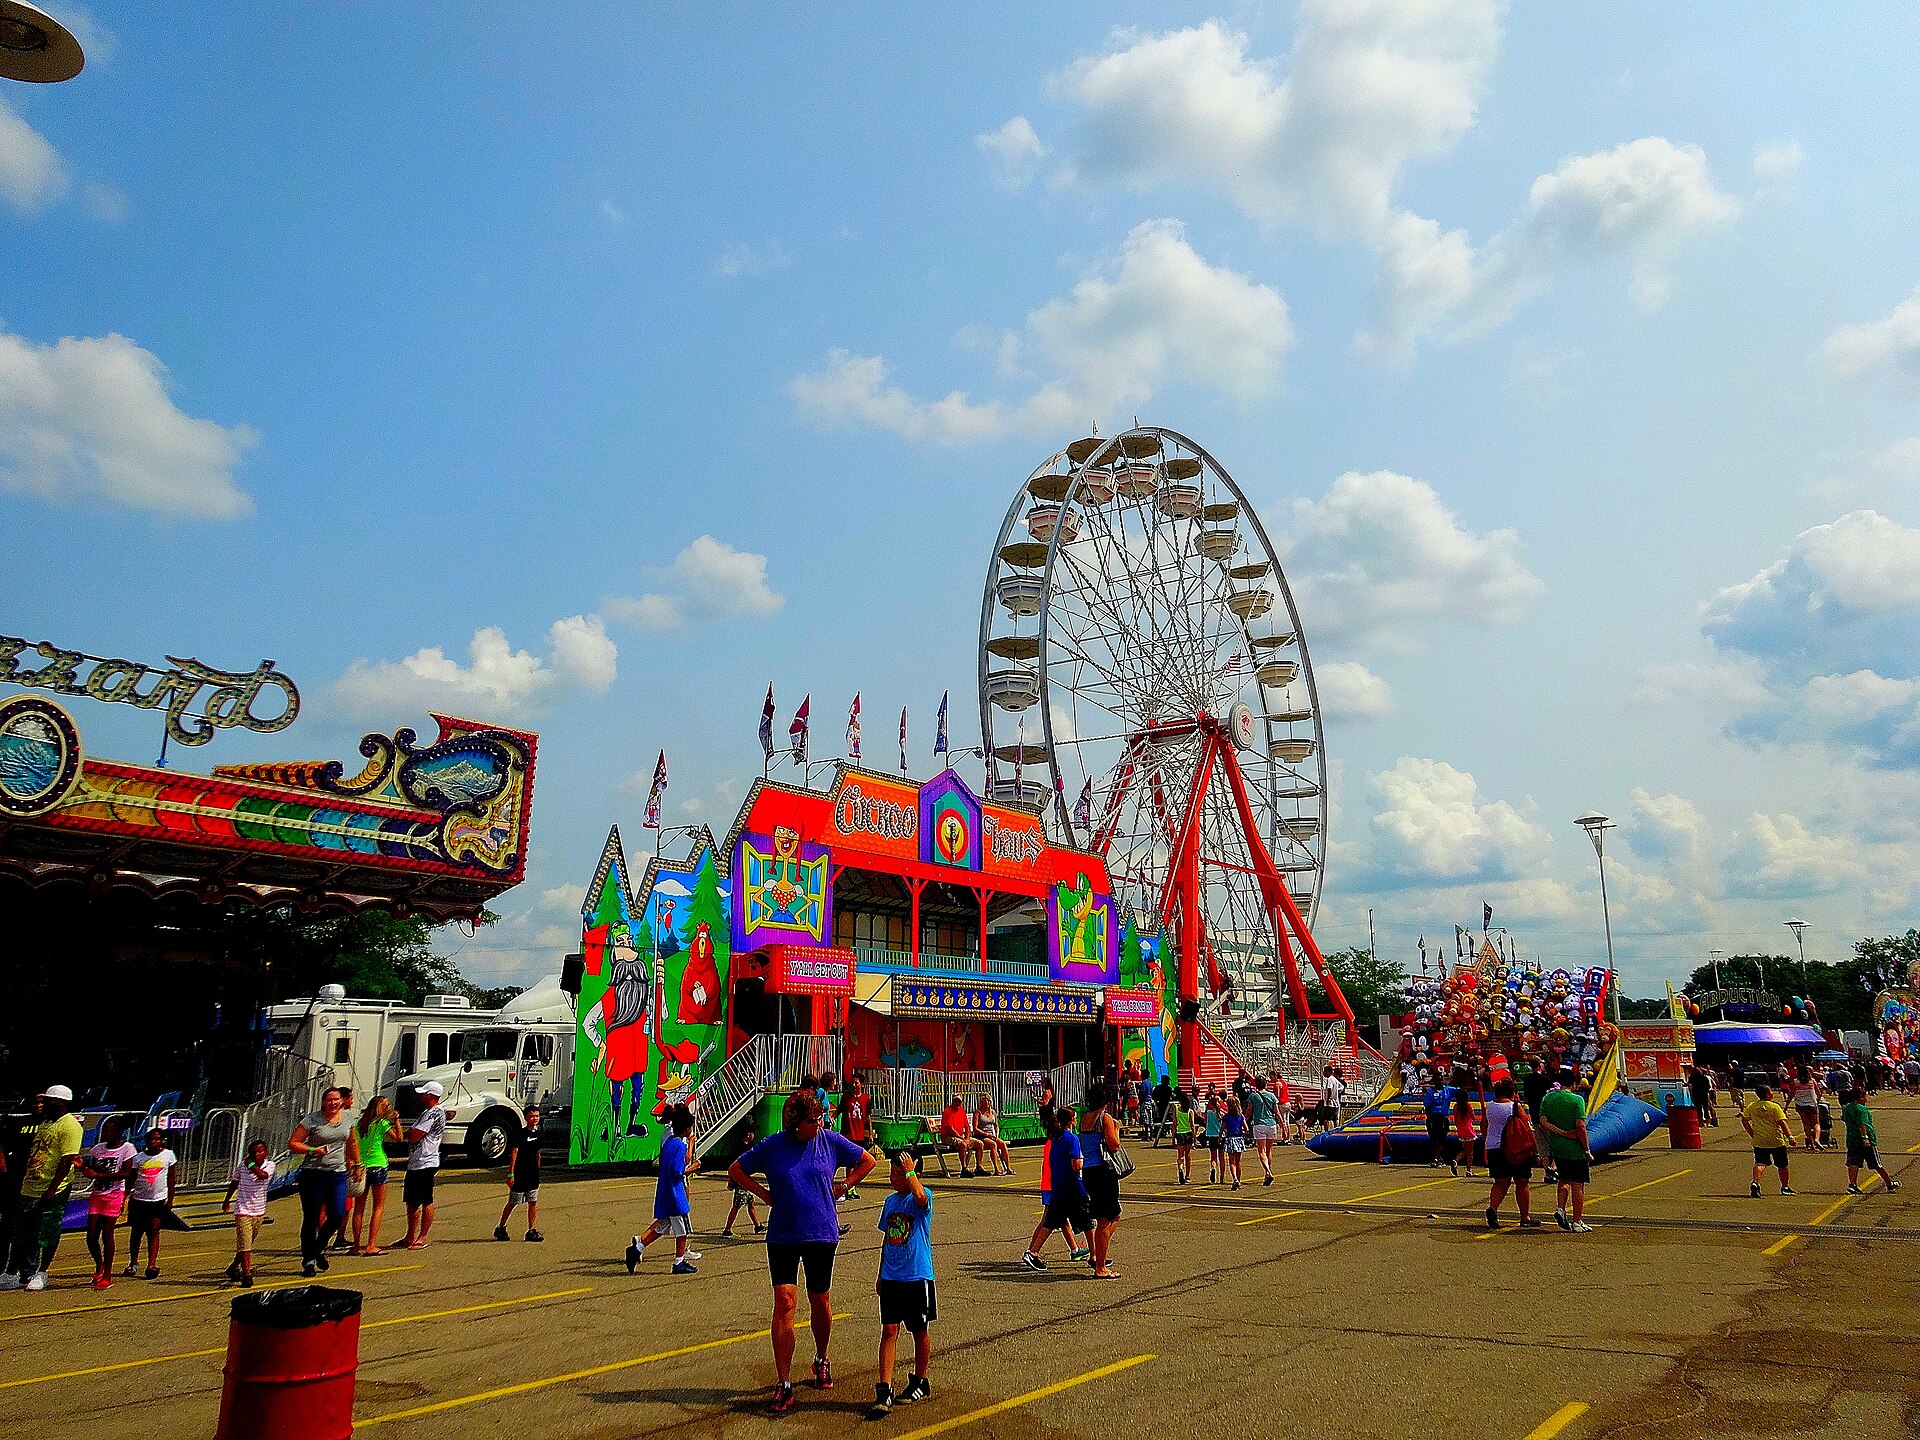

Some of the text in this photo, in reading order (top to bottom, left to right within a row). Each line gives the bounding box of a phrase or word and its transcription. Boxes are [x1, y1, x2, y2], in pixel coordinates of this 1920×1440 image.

[790, 960, 849, 980] Y'ALL GET OUT
[1700, 987, 1782, 1013] ABDUCTION
[170, 1118, 191, 1129] EXIT
